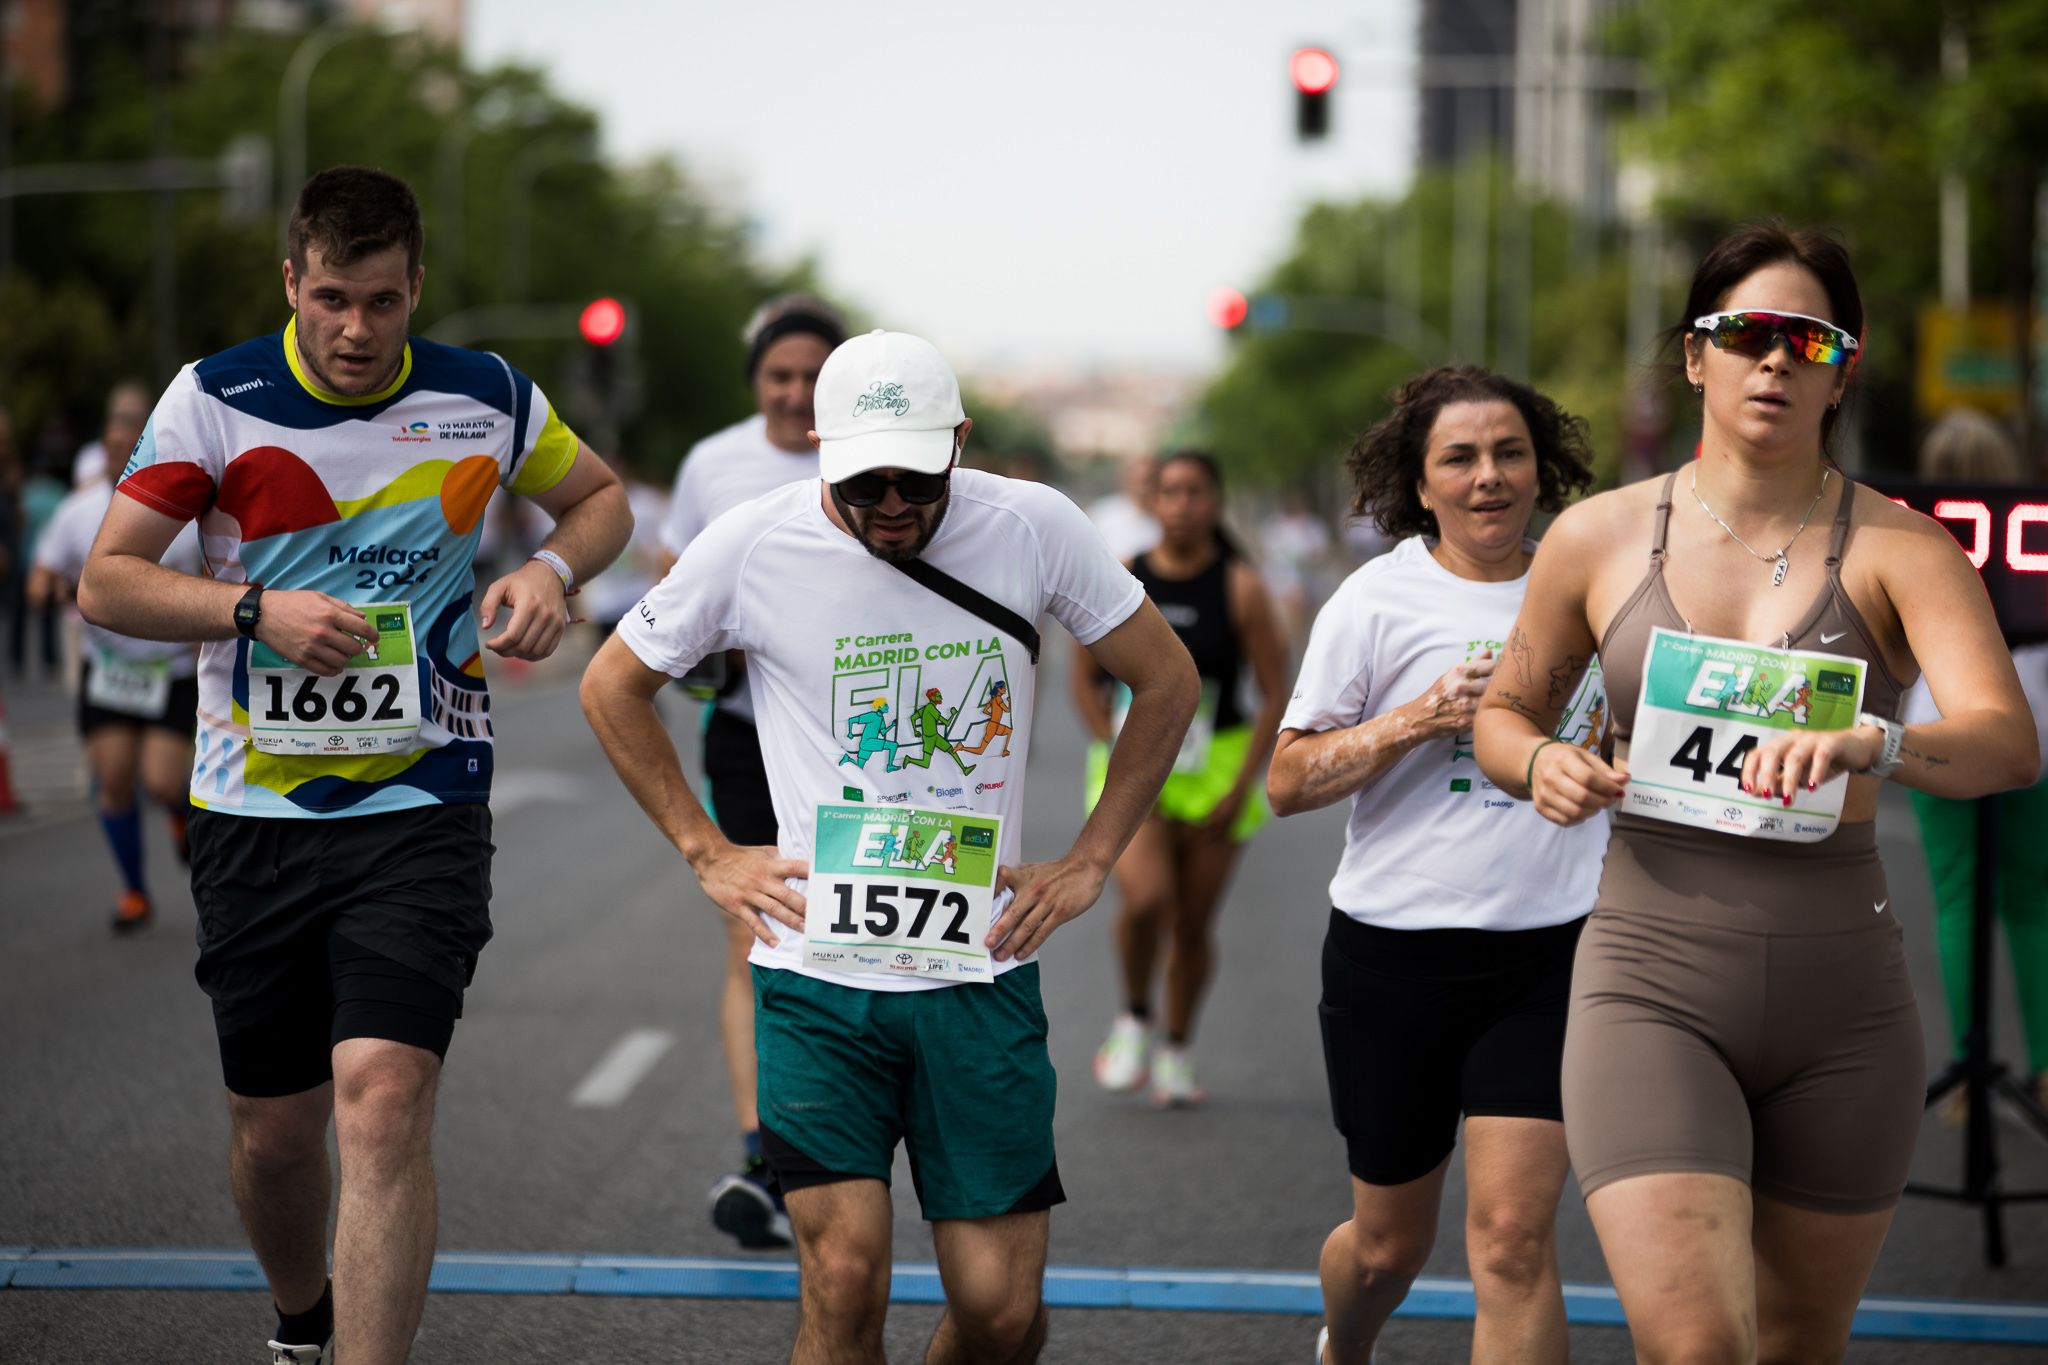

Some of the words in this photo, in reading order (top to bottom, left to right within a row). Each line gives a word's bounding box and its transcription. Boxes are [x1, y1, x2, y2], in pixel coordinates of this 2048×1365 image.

[440, 432, 452, 440] DE
[328, 544, 440, 565] Málaga
[355, 565, 432, 590] 2024
[855, 632, 913, 648] Carrera
[834, 647, 920, 672] MADRID
[925, 641, 971, 661] CON
[976, 636, 1002, 654] LA
[1706, 647, 1758, 664] MADRID
[1760, 656, 1790, 670] CON
[265, 674, 404, 723] 1662
[1686, 660, 1809, 725] ELA
[832, 812, 862, 820] Carrera
[864, 812, 910, 823] MADRID
[912, 816, 936, 826] CON
[938, 818, 952, 828] LA
[852, 824, 955, 874] ELA
[831, 884, 970, 944] 1572
[858, 956, 882, 964] Biogen
